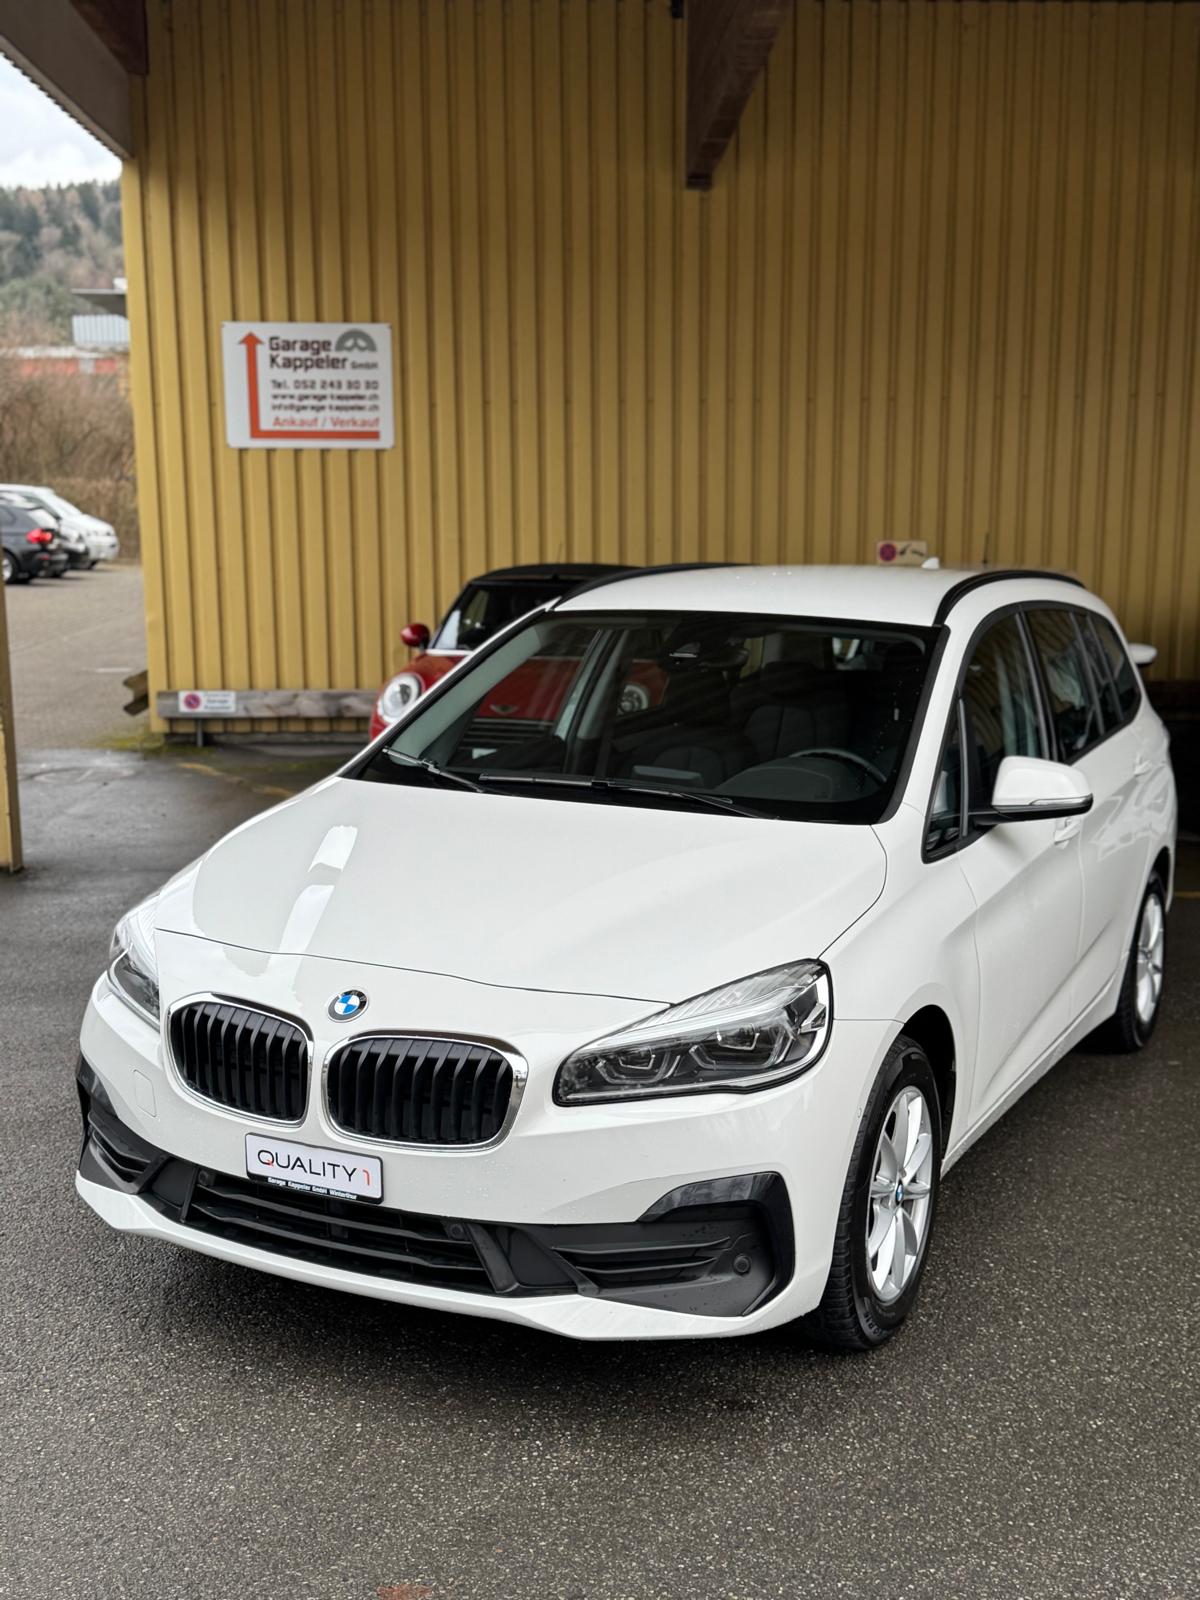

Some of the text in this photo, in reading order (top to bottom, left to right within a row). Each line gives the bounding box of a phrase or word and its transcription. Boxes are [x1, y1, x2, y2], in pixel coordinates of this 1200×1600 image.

[269, 336, 332, 356] Garage
[269, 355, 348, 372] Kappeler
[271, 380, 290, 390] Tel.
[294, 380, 317, 390] 052
[273, 417, 318, 427] Ankauf
[331, 417, 380, 427] Verkauf
[258, 1149, 371, 1186] QUALITY 1
